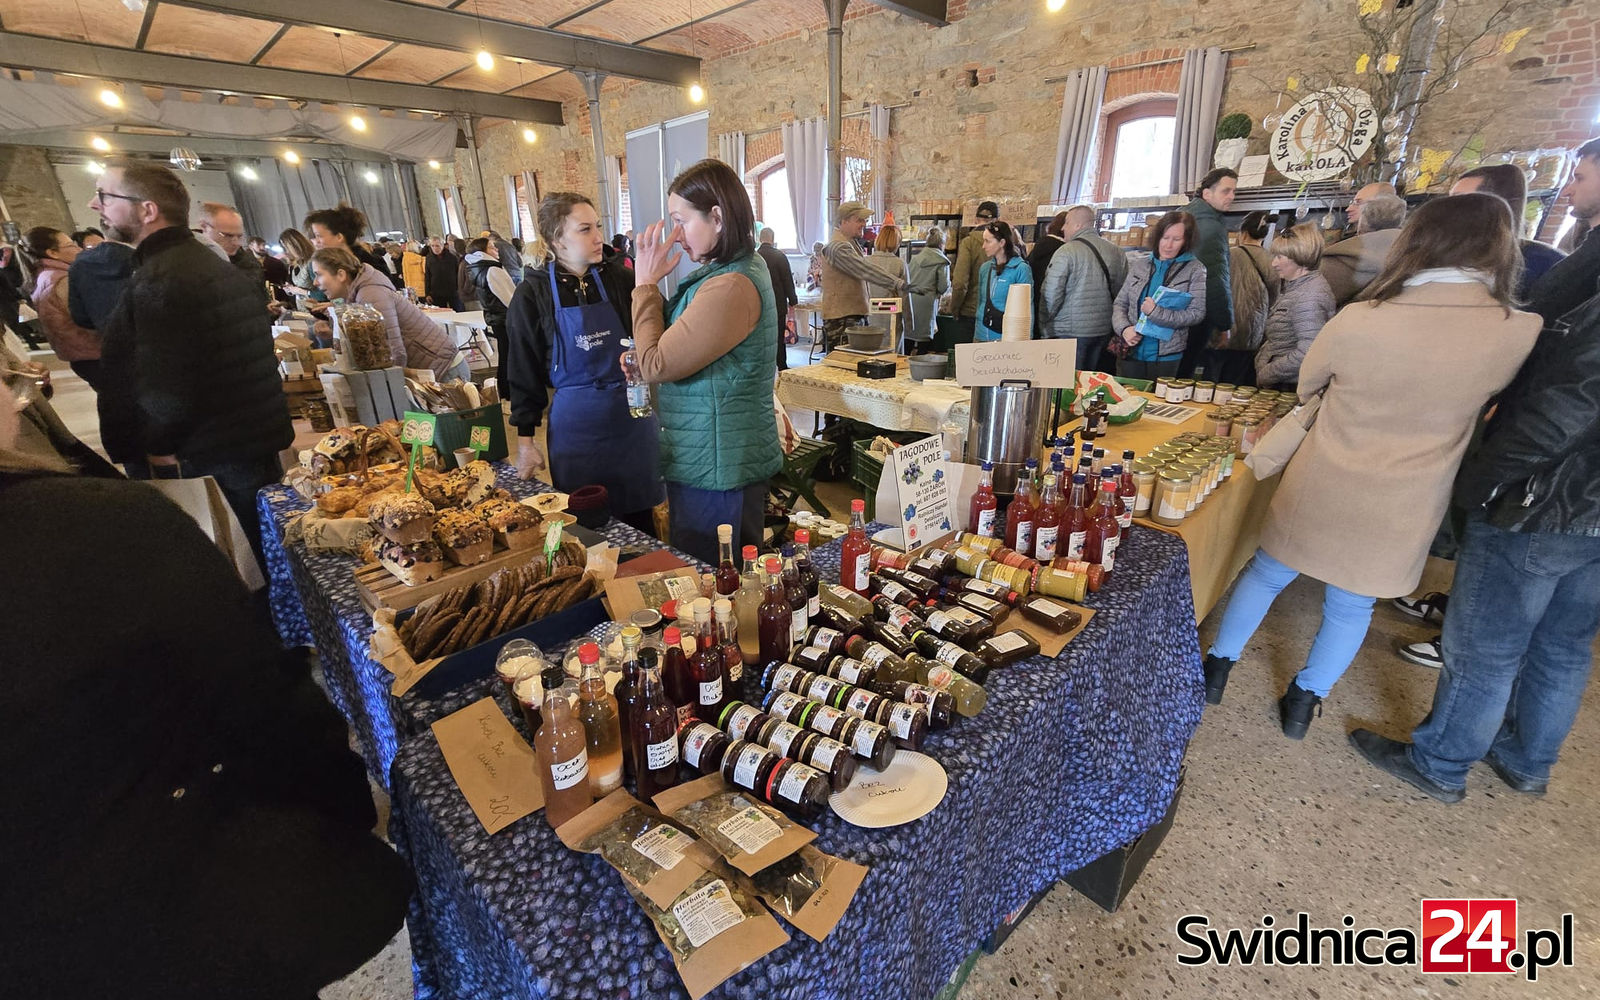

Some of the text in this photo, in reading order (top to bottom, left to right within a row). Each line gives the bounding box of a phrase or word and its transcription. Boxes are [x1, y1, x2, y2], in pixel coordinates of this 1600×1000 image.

[1276, 107, 1307, 161] Karolina
[1352, 109, 1374, 146] Ożga
[898, 438, 940, 462] JAGODOWE
[922, 450, 942, 466] POLE
[674, 891, 706, 914] Herbata
